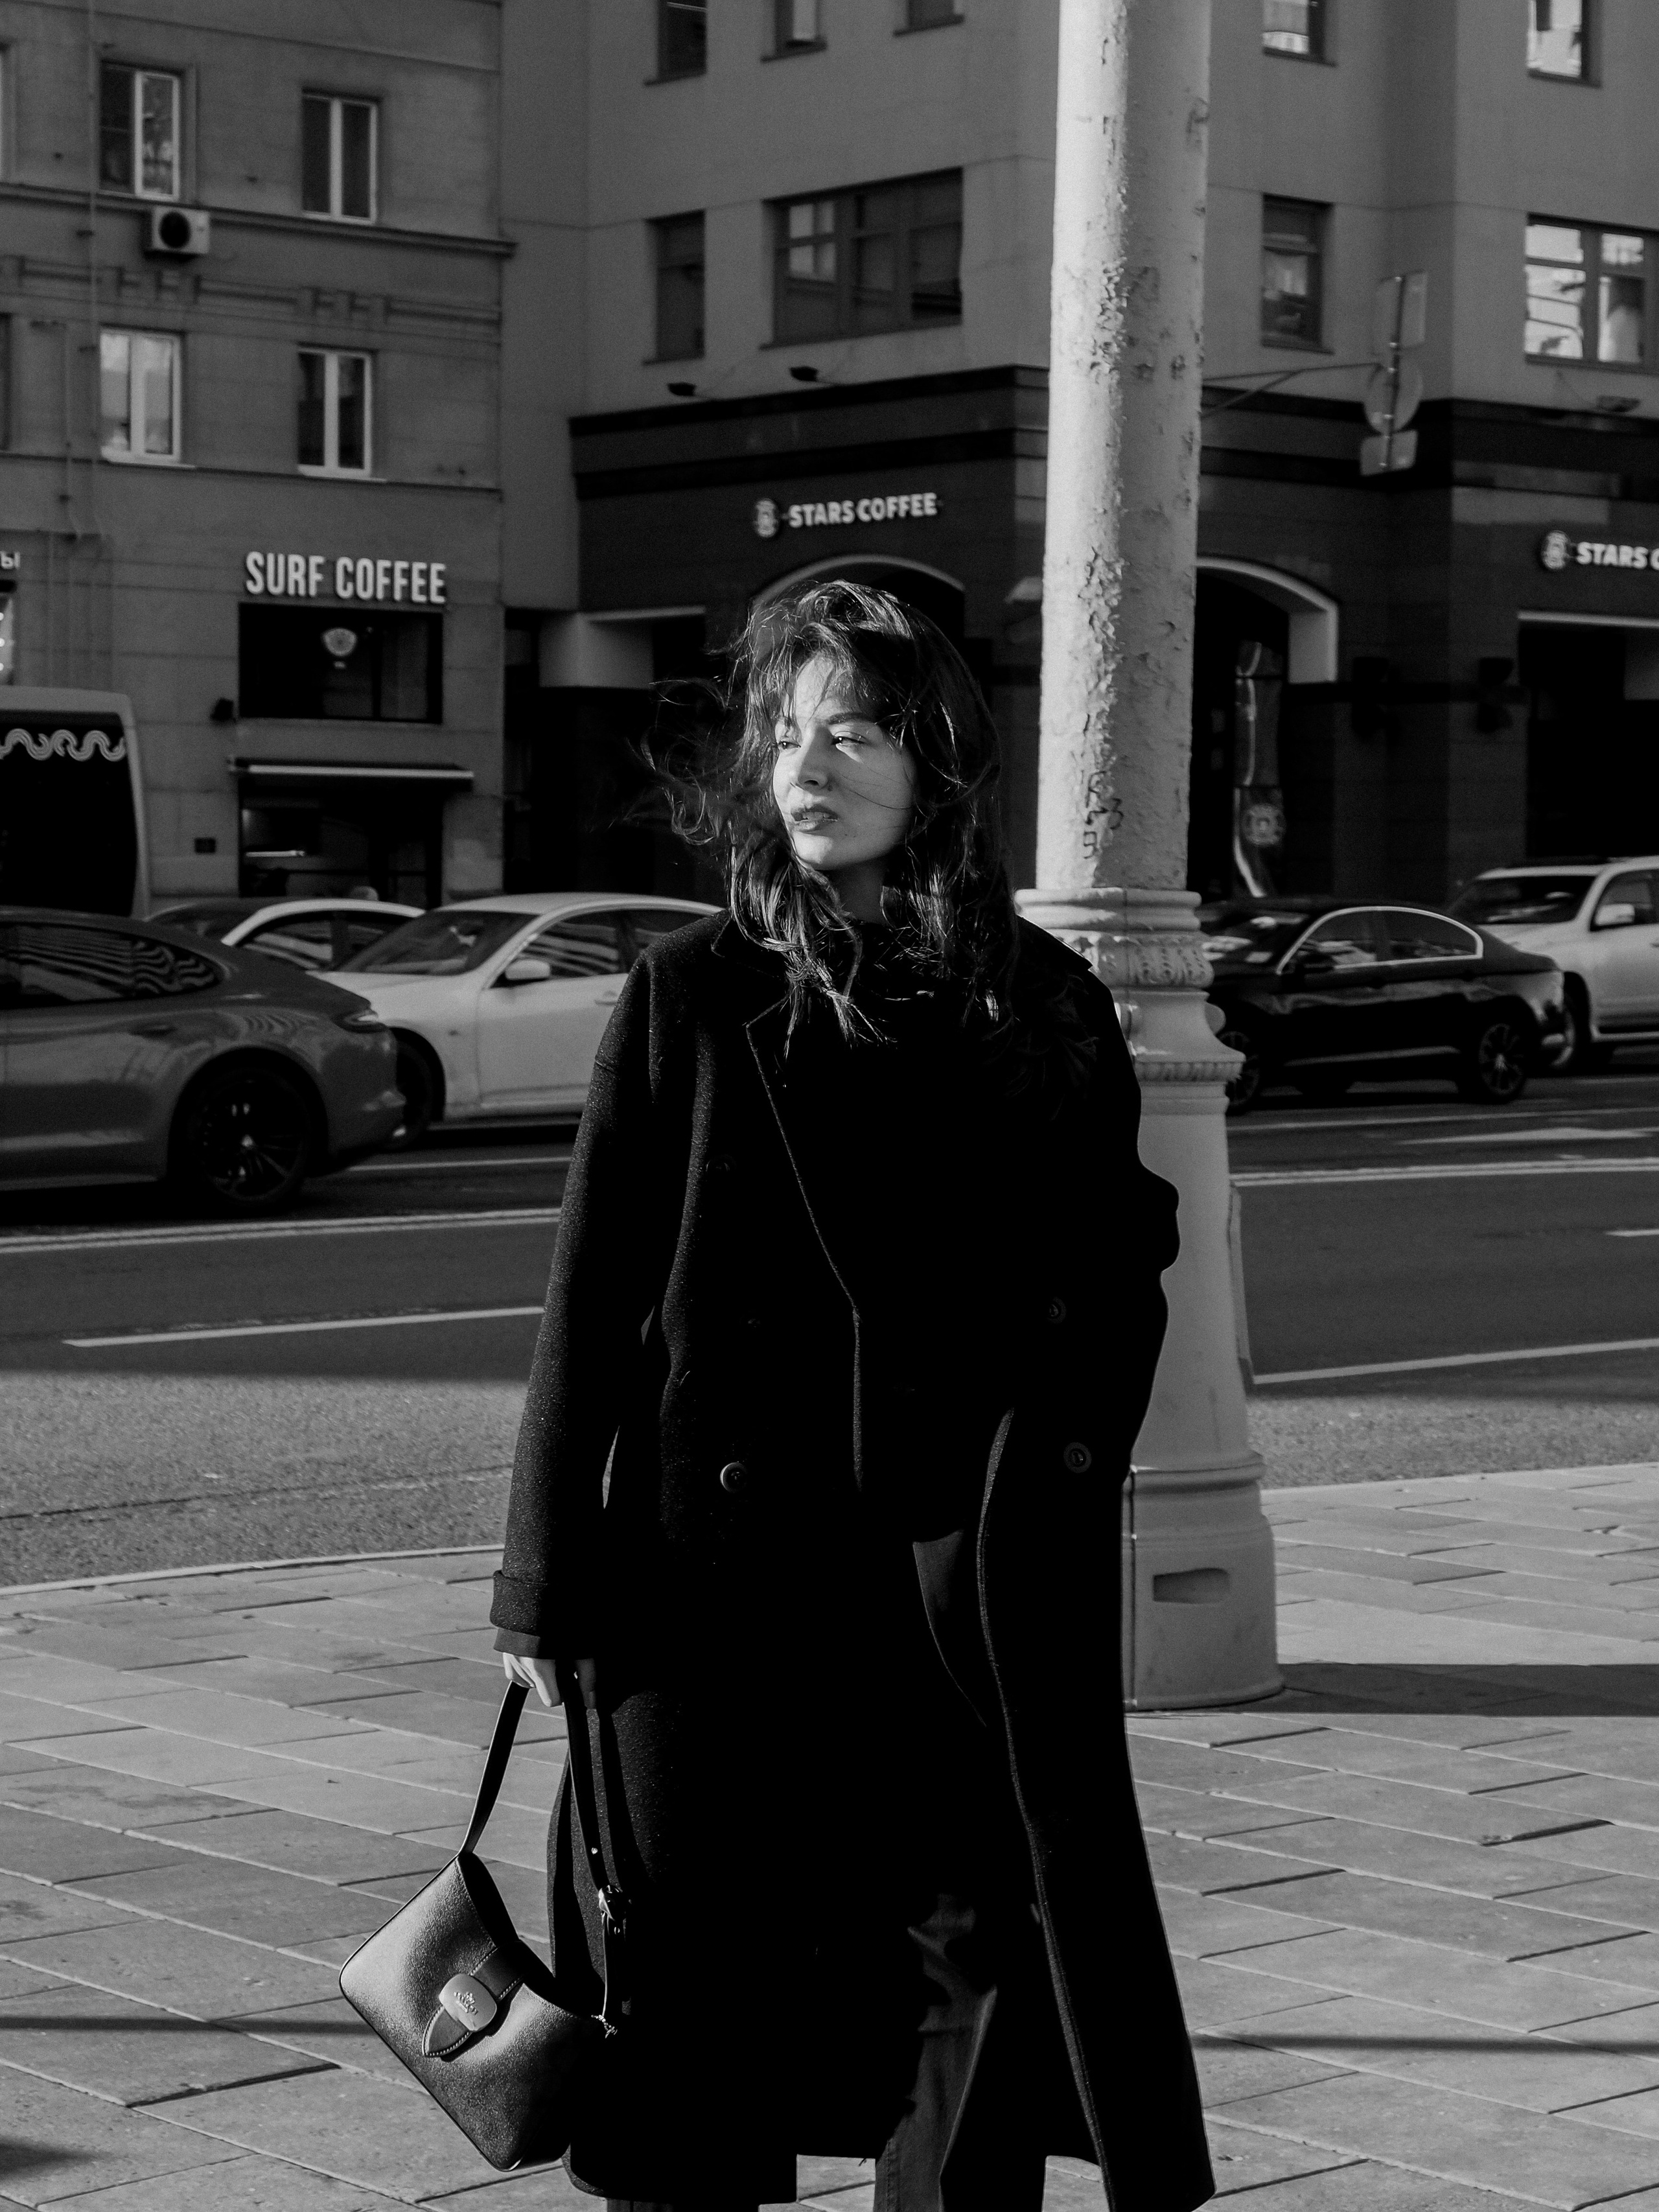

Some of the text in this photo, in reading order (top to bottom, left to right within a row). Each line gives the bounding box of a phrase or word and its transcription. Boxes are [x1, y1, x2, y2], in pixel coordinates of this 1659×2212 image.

[789, 492, 937, 528] STARS COFFEE
[1576, 541, 1649, 569] STARS
[246, 551, 446, 603] SURF COFFEE
